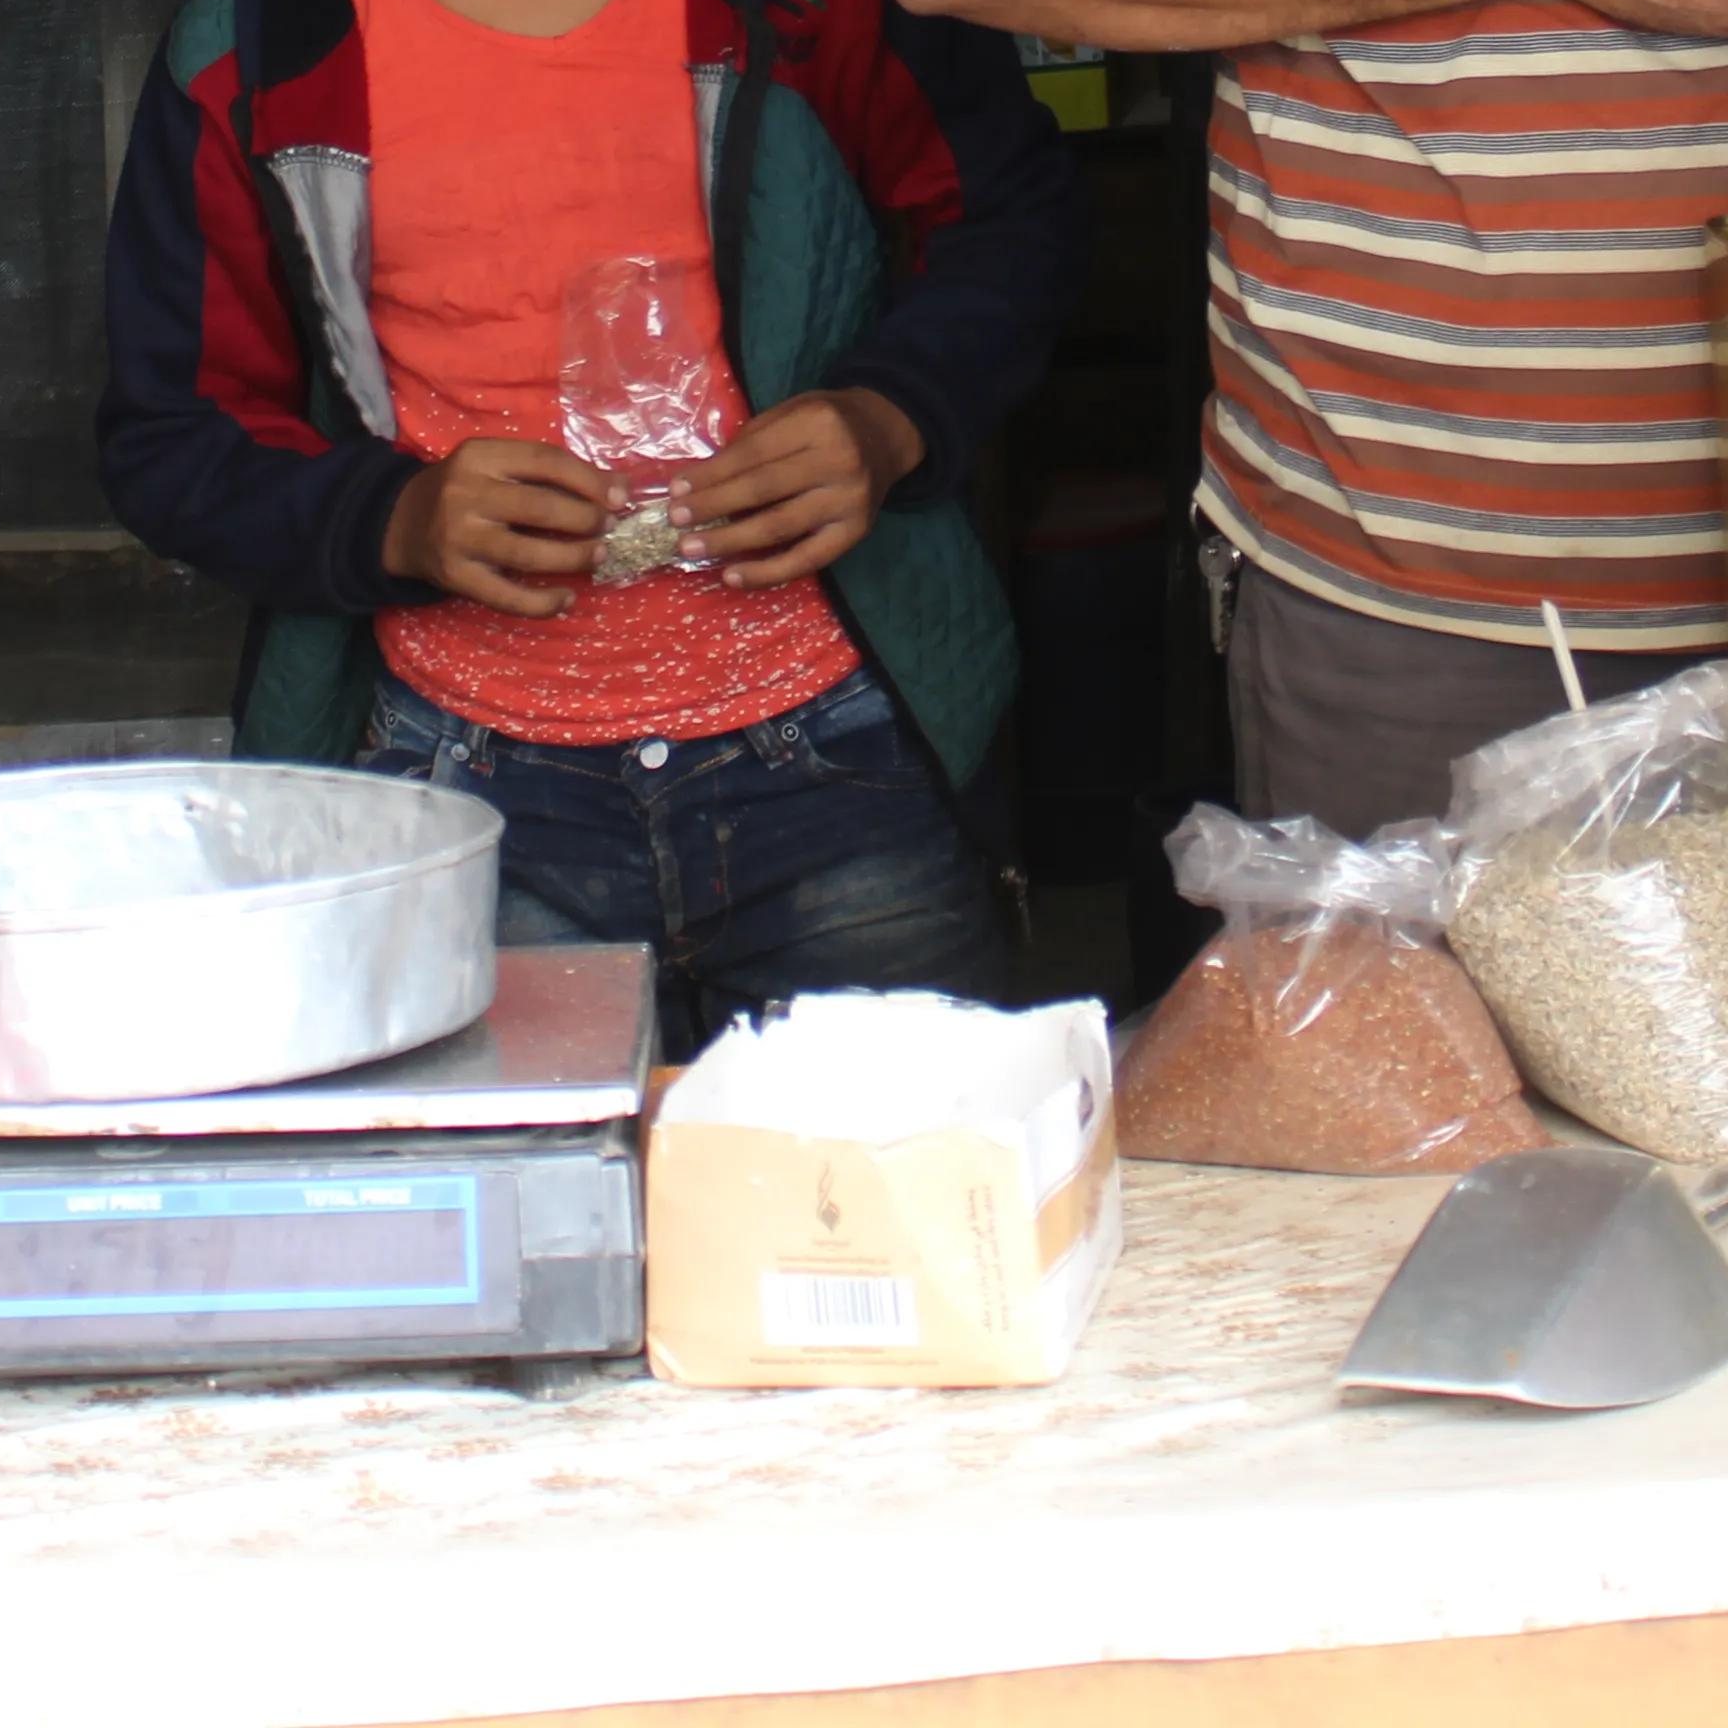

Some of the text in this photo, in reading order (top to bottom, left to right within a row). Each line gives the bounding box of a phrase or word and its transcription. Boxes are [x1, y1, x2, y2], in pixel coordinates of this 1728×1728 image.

[110, 1190, 163, 1212] PRICE
[304, 1186, 412, 1209] TOTAL PRICE
